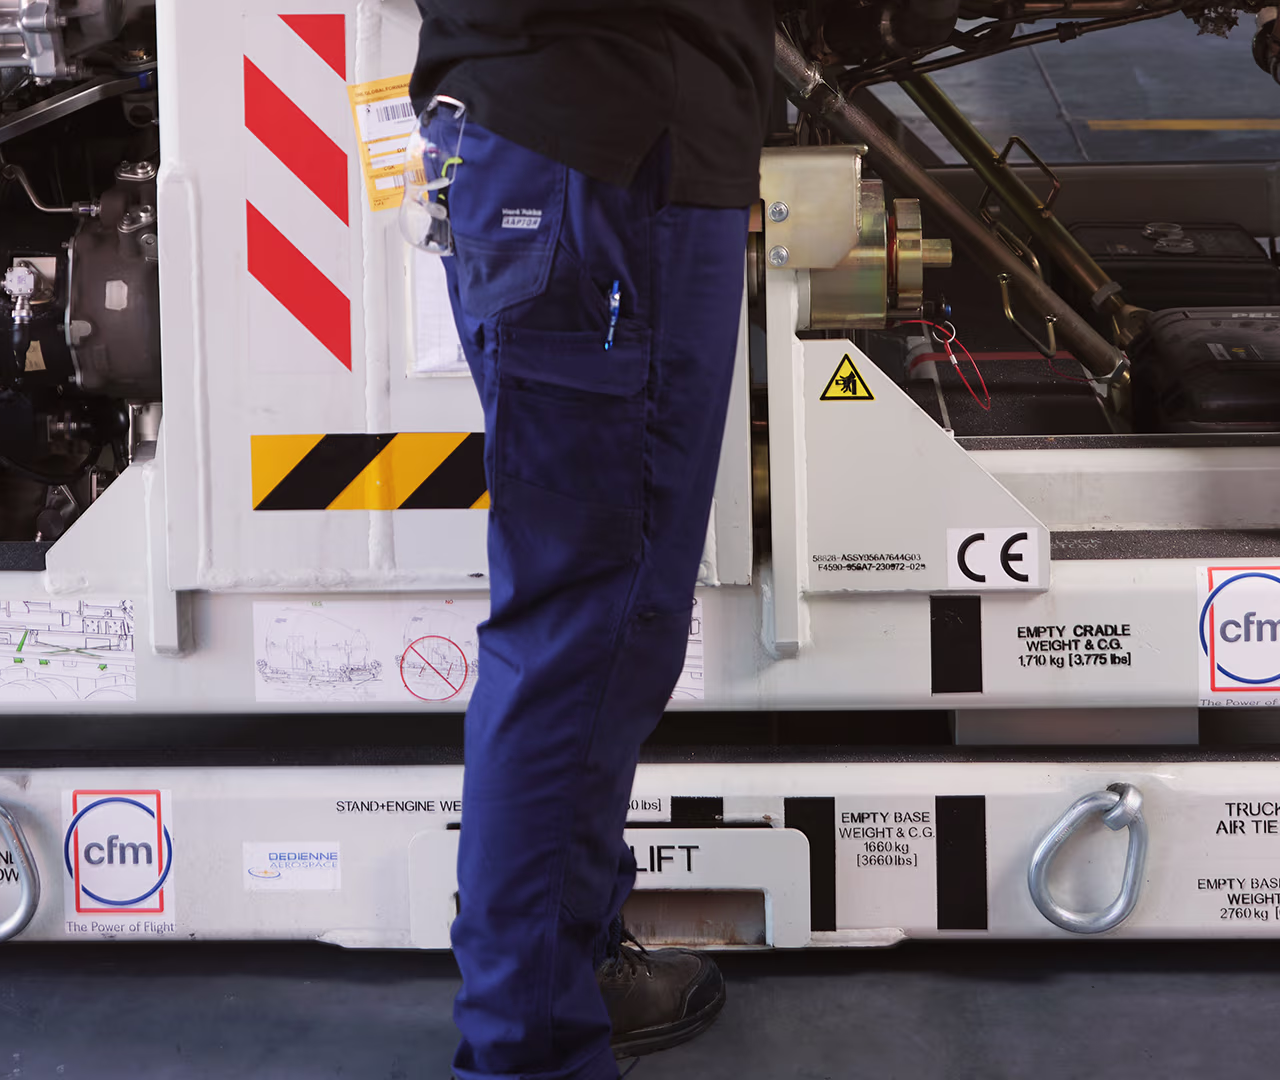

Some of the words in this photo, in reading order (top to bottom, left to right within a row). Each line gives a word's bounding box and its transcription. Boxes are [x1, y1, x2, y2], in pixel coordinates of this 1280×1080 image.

[1018, 626, 1065, 638] EMPTY
[1073, 625, 1130, 637] CRADLE
[1027, 639, 1080, 651] WEIGHT
[1085, 639, 1094, 650] &
[1097, 639, 1122, 650] C.G.
[1019, 655, 1046, 667] 1,710
[1050, 655, 1064, 668] kg
[1110, 652, 1131, 666] lbs]
[1200, 698, 1222, 707] The
[1225, 698, 1262, 707] Power
[336, 801, 435, 813] STAND+ENGINE
[642, 798, 661, 812] lbs]
[842, 812, 888, 823] EMPTY
[894, 812, 930, 822] BASE
[839, 827, 893, 838] WEIGHT
[896, 827, 904, 838] &
[908, 826, 935, 838] C.G.
[1216, 820, 1245, 834] AIR
[1252, 820, 1277, 833] TIE
[84, 835, 152, 865] cfm
[269, 852, 338, 861] DEDIENNE
[637, 845, 699, 873] LIFT
[270, 861, 338, 869] AEROSPACE
[1198, 878, 1245, 889] EMPTY
[67, 921, 88, 933] The
[91, 921, 125, 933] Power
[129, 921, 141, 933] of
[143, 921, 174, 935] Flight
